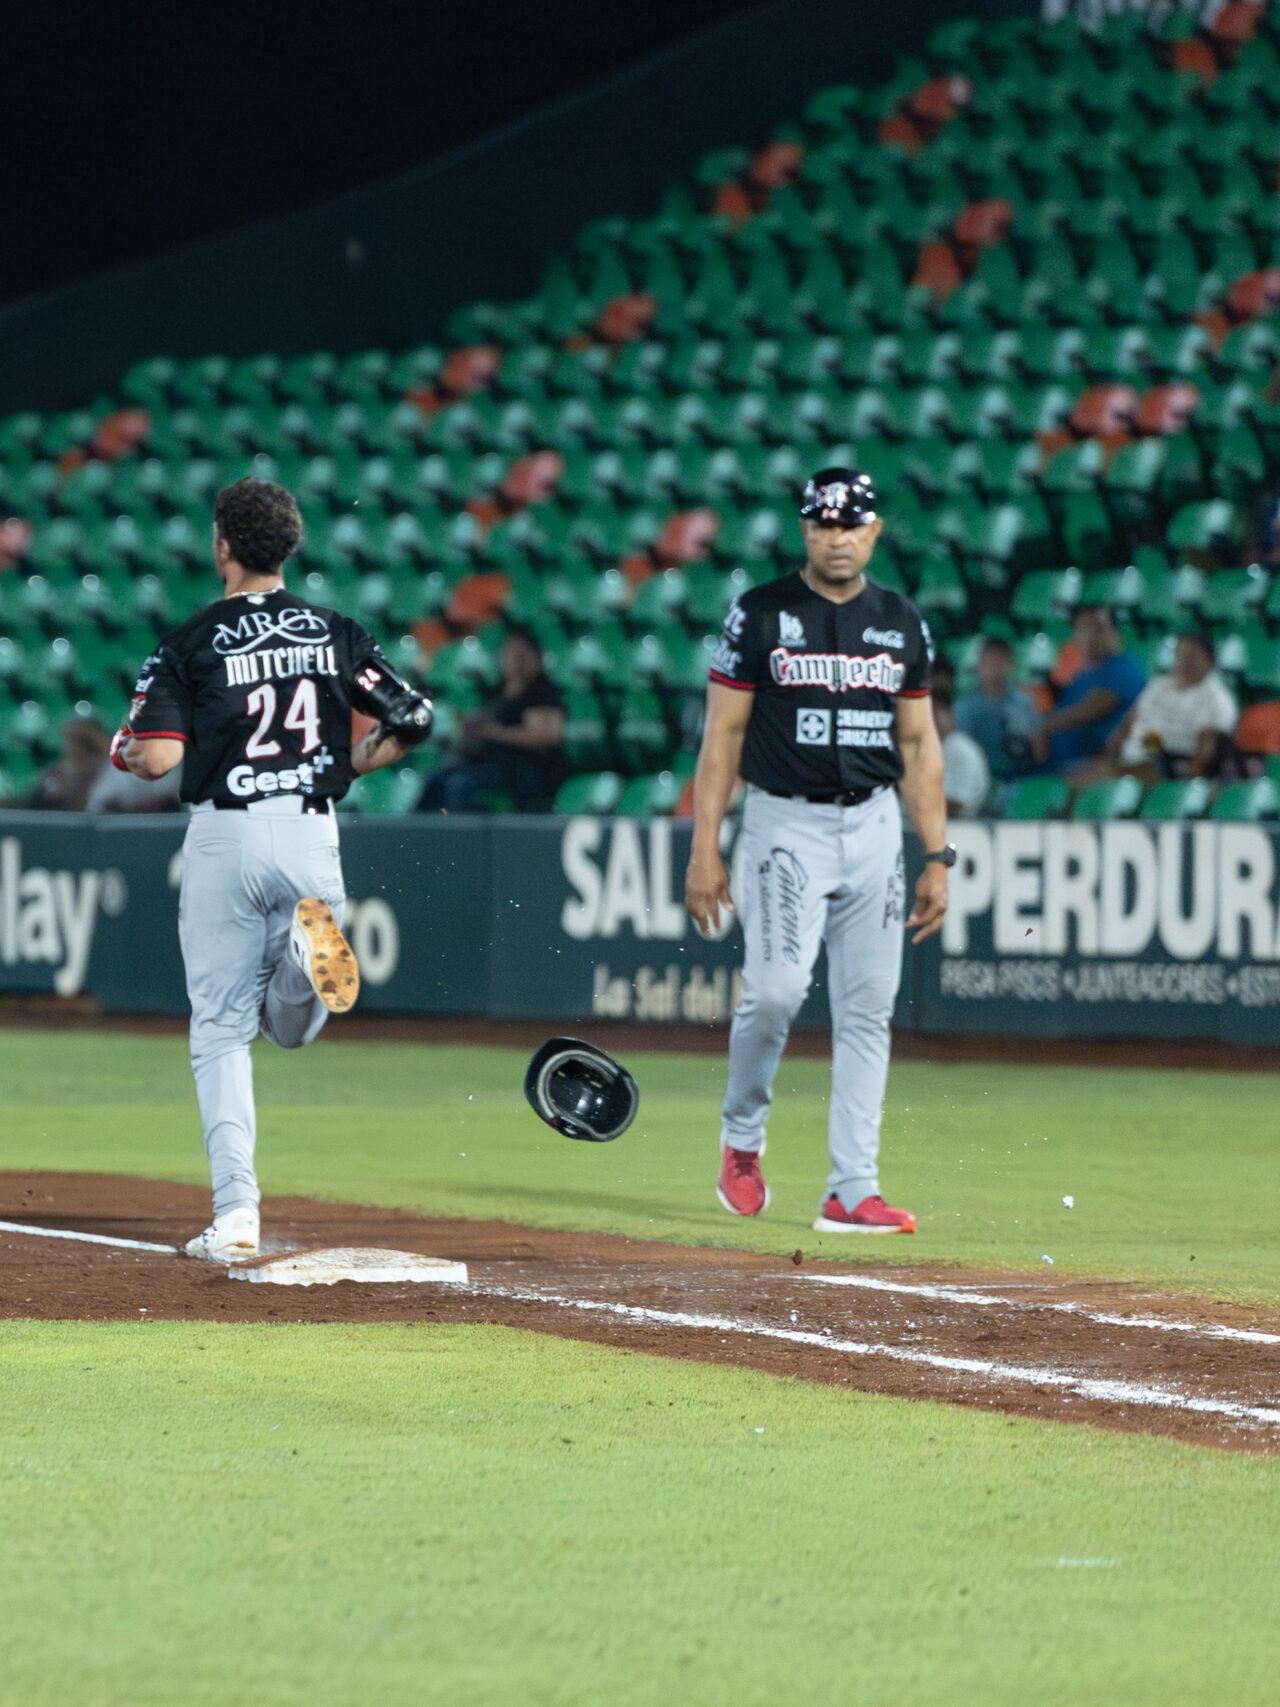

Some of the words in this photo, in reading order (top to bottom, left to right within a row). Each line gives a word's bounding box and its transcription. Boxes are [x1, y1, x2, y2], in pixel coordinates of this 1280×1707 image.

[224, 645, 339, 687] MITCHELL
[357, 668, 381, 691] 24
[769, 647, 906, 693] Campeche
[244, 677, 321, 760] 24
[561, 815, 686, 940] SAL
[770, 847, 809, 965] Caliente
[942, 820, 1280, 960] PERDUR
